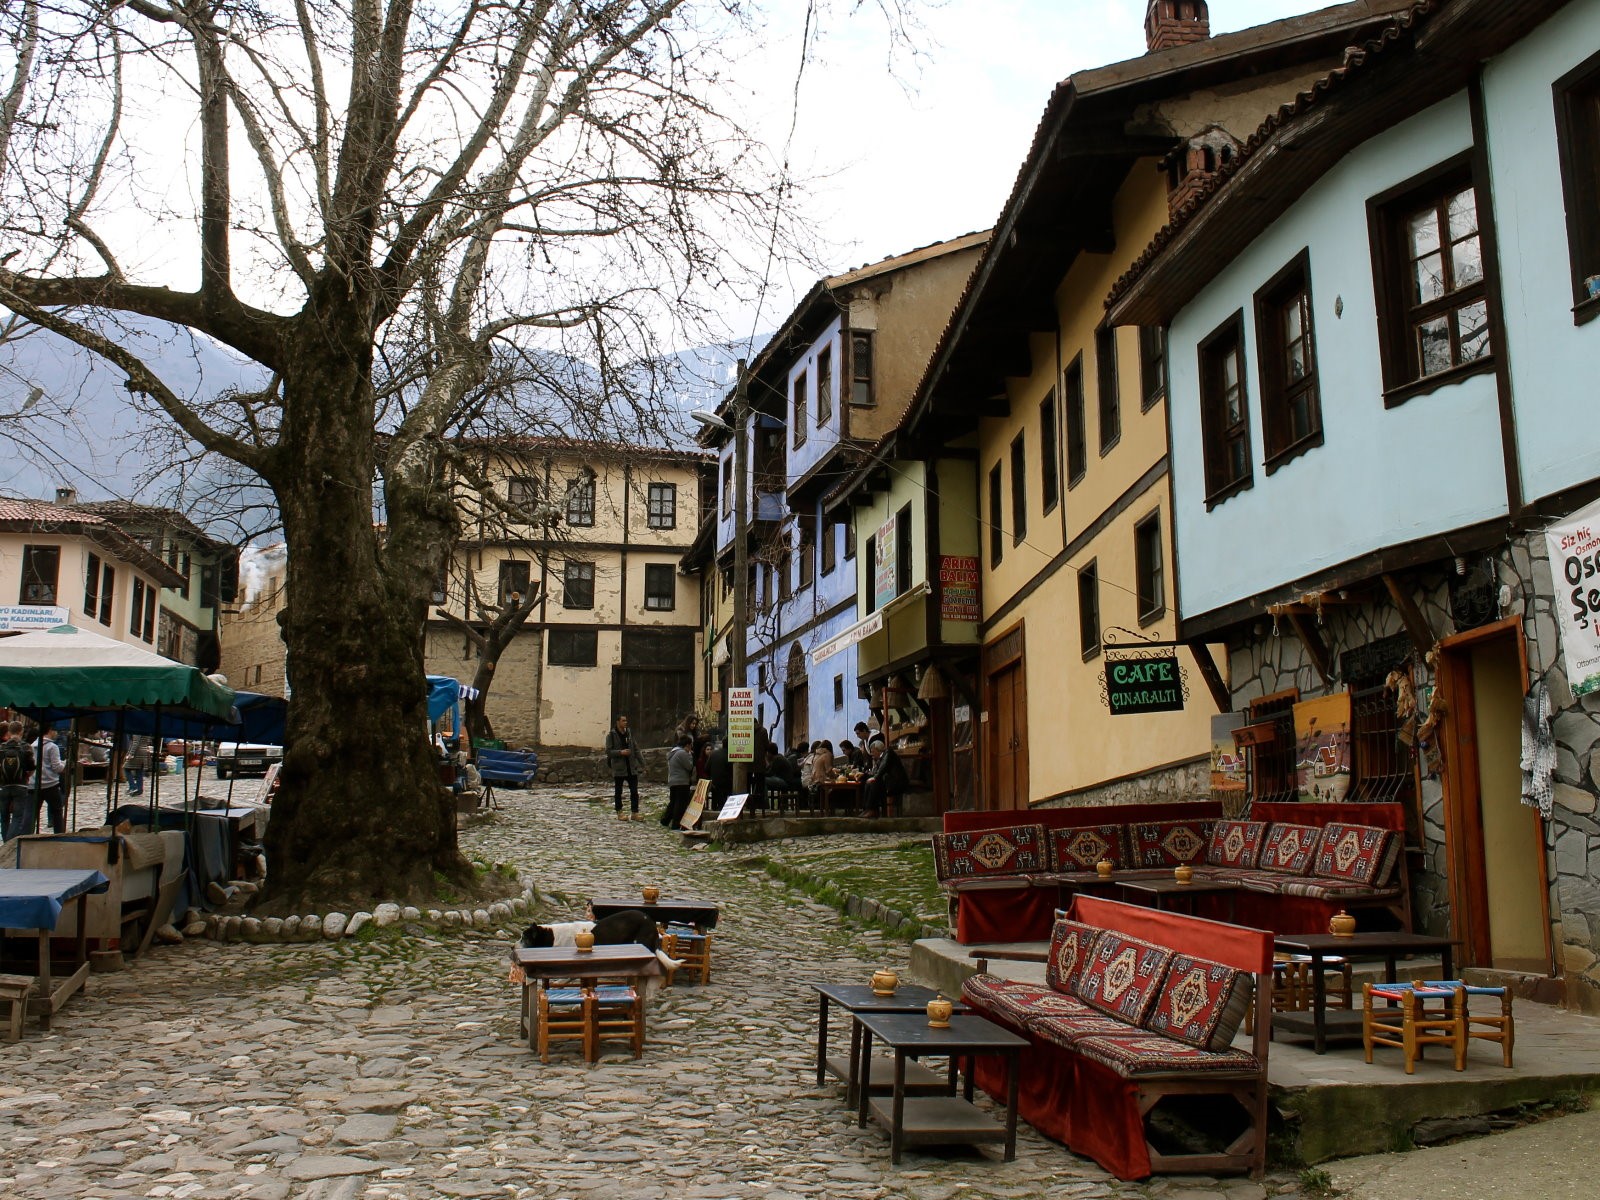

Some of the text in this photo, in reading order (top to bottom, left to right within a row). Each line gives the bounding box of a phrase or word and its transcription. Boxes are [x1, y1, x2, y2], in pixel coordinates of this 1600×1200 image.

[1561, 526, 1592, 551] Siz hiç
[942, 557, 976, 570] ARIM
[940, 569, 979, 583] BALIM
[1113, 662, 1174, 684] CAFE
[1111, 689, 1177, 710] ÇINARALTI
